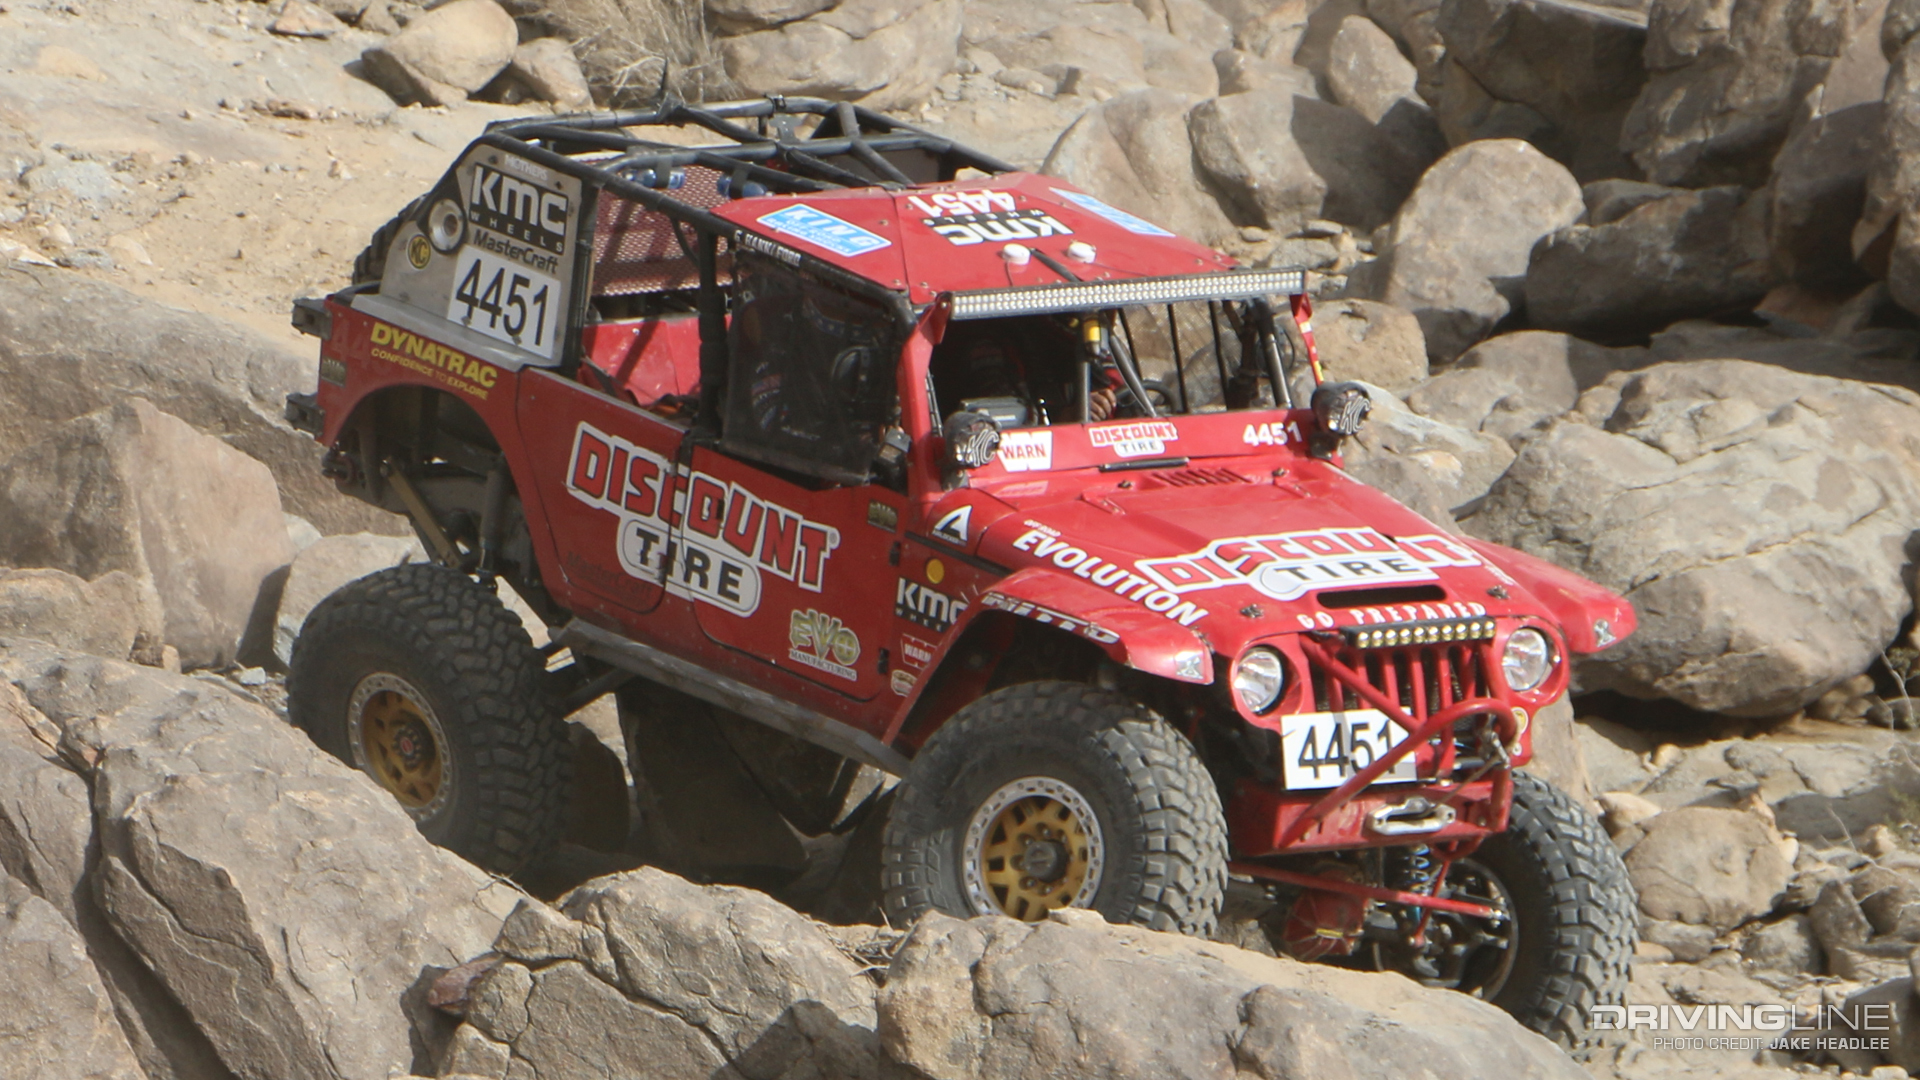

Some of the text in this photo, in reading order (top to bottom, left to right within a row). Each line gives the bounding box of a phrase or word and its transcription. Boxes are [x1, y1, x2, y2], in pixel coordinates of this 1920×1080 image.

[504, 154, 549, 180] MOTHERS
[907, 189, 1017, 218] 4451
[470, 210, 563, 252] WHEELS
[783, 209, 881, 247] KING
[410, 236, 428, 265] KC
[474, 229, 559, 275] MasterCraft
[455, 258, 549, 347] 4451
[370, 321, 498, 388] DYNATRAC
[371, 348, 434, 378] CONFIDENCE
[434, 370, 447, 383] TO
[447, 376, 489, 400] EXPLORE
[1242, 421, 1303, 447] 4451
[1339, 394, 1371, 435] KC
[968, 428, 998, 467] KC
[1001, 444, 1047, 460] WARN
[1091, 423, 1176, 446] DISCOUNT
[1121, 441, 1159, 452] TIRE
[569, 422, 834, 591] DISCOUNT
[635, 527, 743, 604] TIRE
[1012, 529, 1209, 627] EVOLUTION
[1274, 557, 1421, 581] TIRE
[981, 590, 1121, 645] NITTO
[1297, 602, 1486, 629] GO PREPARED
[789, 608, 861, 667] EVO
[903, 642, 932, 664] WARN
[789, 649, 857, 681] MANUFACTURING
[1298, 718, 1396, 780] 4451
